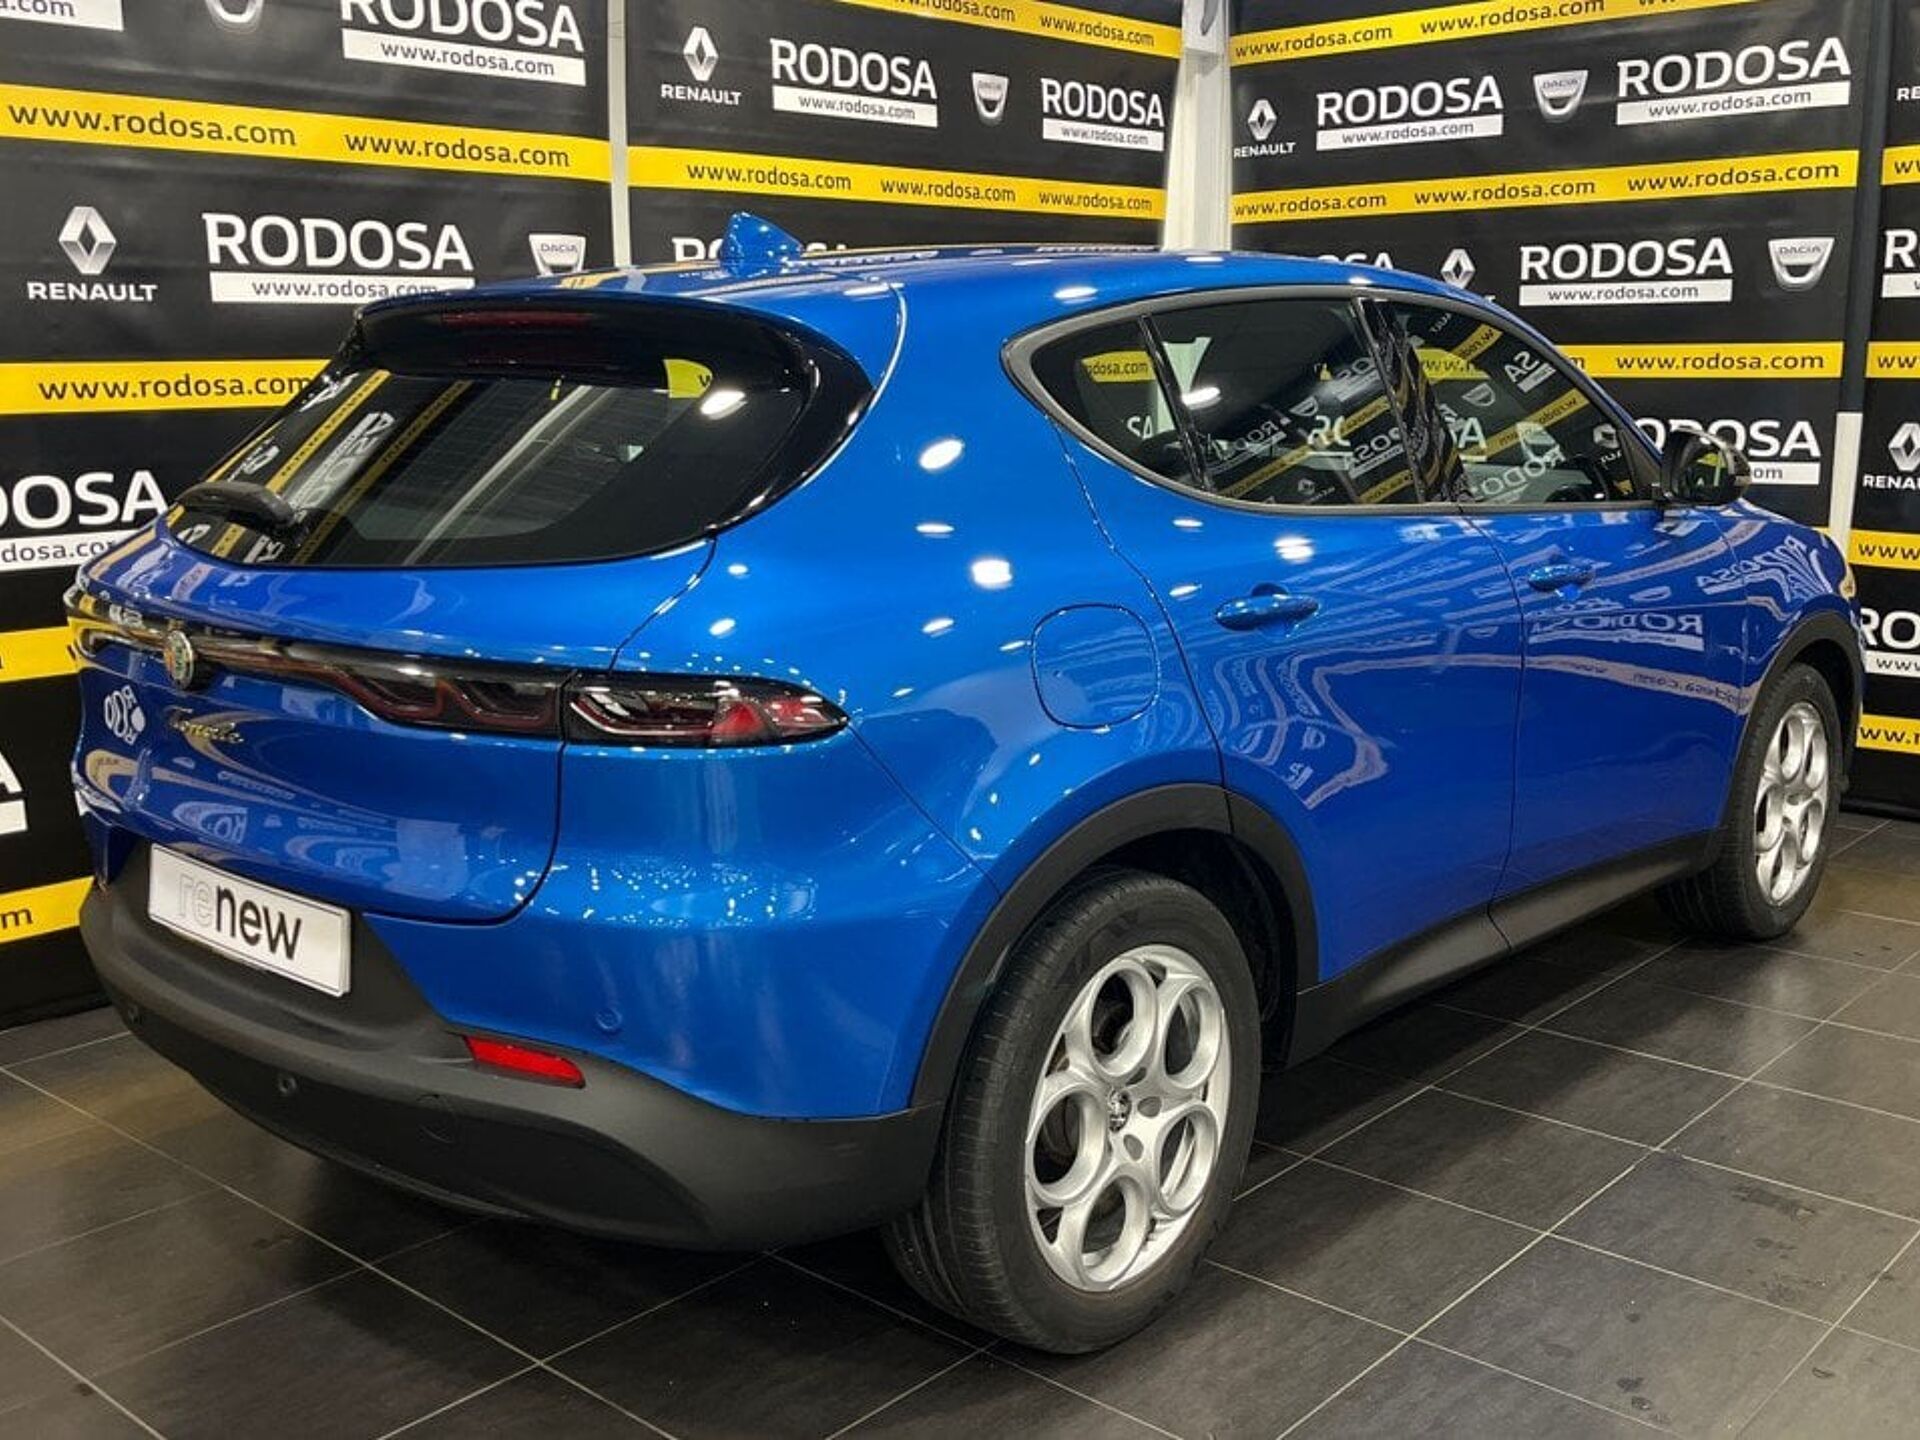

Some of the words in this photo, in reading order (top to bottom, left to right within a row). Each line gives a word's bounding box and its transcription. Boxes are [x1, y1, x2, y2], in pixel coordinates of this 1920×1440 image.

[1040, 14, 1155, 46] www.rodosa.com
[1236, 26, 1393, 57] www.rodosa.com
[380, 41, 555, 76] www.rodosa.com
[770, 38, 938, 99] RODOSA
[1617, 37, 1851, 98] RODOSA
[661, 84, 742, 105] RENAULT
[798, 95, 915, 120] www.rodosa.com
[1041, 77, 1165, 127] RODOSA
[1316, 75, 1504, 126] RODOSA
[1649, 90, 1811, 119] www.rodosa.com
[9, 105, 297, 146] www.rodosa.com
[1341, 121, 1475, 144] www.rodosa.com
[344, 133, 570, 168] www.rodosa.com
[1233, 142, 1296, 159] RENAULT
[687, 165, 851, 190] www.rodosa.com
[881, 178, 1016, 202] www.rodosa.com
[1627, 162, 1840, 192] www.rodosa.com
[1039, 191, 1152, 210] www.rodosa.com
[1234, 194, 1387, 217] www.rodosa.com
[1415, 183, 1596, 205] www.rodosa.com
[202, 212, 474, 271] RODOSA
[1520, 237, 1733, 281] RODOSA
[27, 282, 158, 301] RENAULT
[1548, 284, 1699, 302] www.rodosa.com
[1617, 354, 1824, 371] www.rodosa.com
[0, 470, 169, 529] OSA
[178, 873, 303, 960] renew
